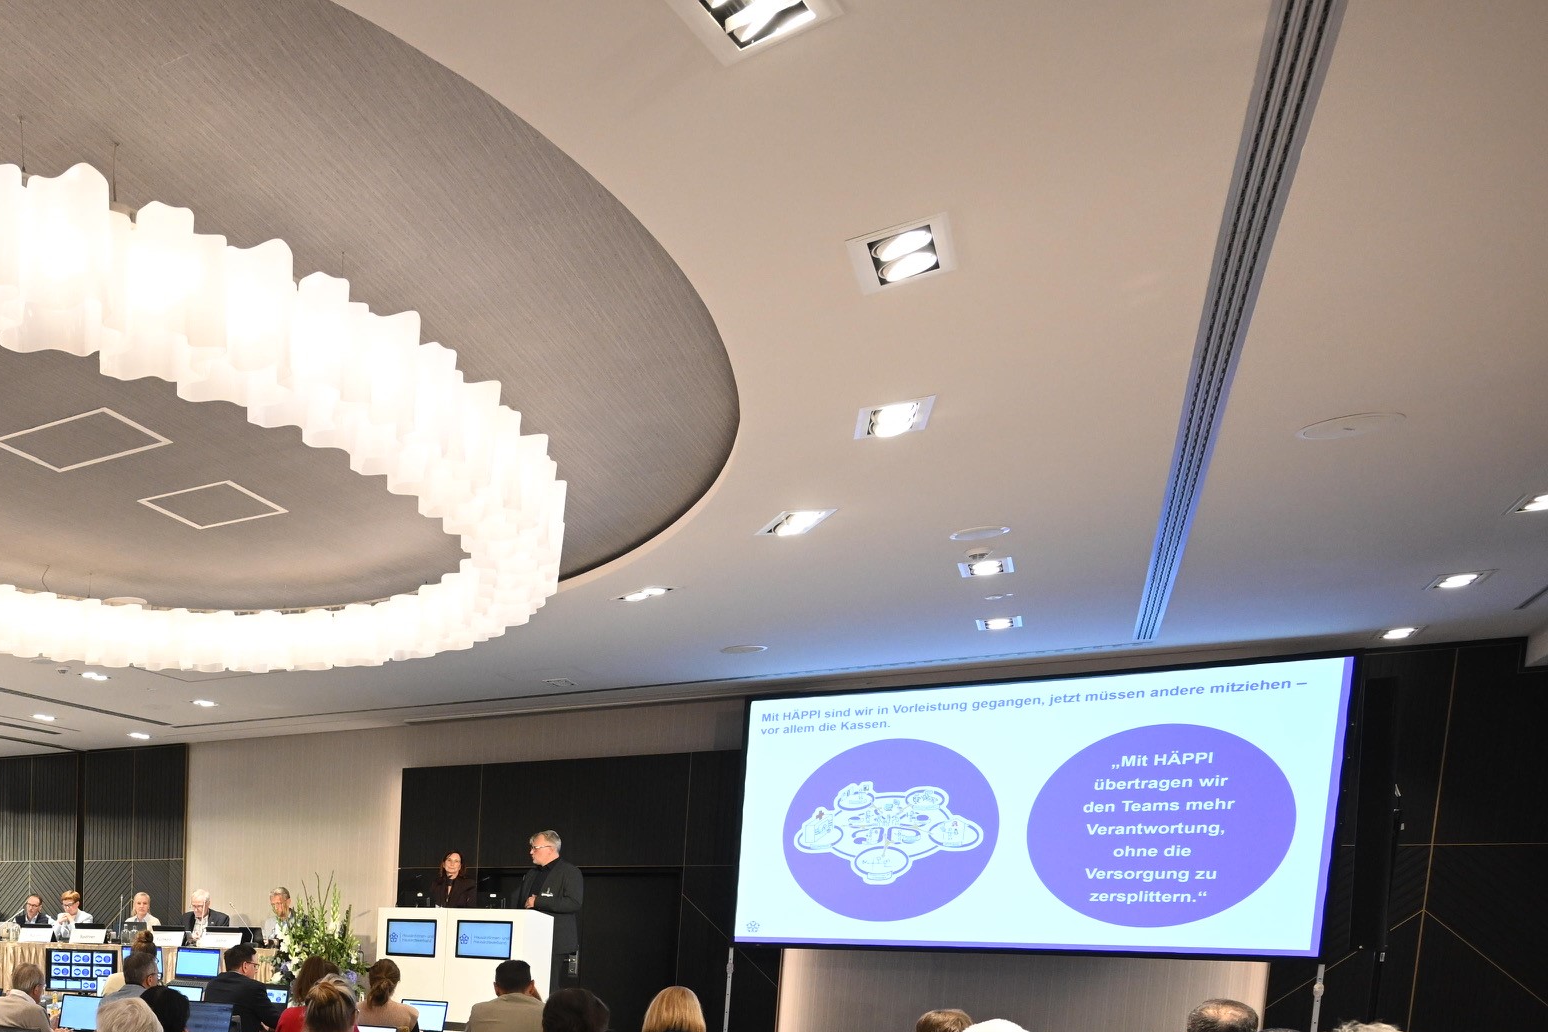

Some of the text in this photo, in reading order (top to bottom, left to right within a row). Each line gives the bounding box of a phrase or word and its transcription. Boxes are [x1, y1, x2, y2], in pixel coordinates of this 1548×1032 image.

[761, 712, 779, 722] Mit
[783, 709, 821, 721] HÄPPI
[824, 708, 851, 719] sind
[854, 706, 874, 717] wir
[877, 705, 889, 715] in
[893, 701, 968, 714] Vorleistung
[972, 696, 1045, 711] gegangen,
[1048, 692, 1081, 706] jetzt
[1085, 690, 1145, 702] müssen
[1150, 685, 1205, 697] andere
[1210, 680, 1291, 694] mitziehen
[760, 719, 891, 735] vor allem die Kassen.
[1153, 750, 1214, 766] HÄPPI
[1094, 775, 1229, 791] übertragen wir
[1083, 798, 1236, 813] den Teams mehr
[1086, 822, 1226, 837] Verantwortung,
[1112, 844, 1192, 857] ohne die
[1085, 868, 1217, 882] Versorgung zu
